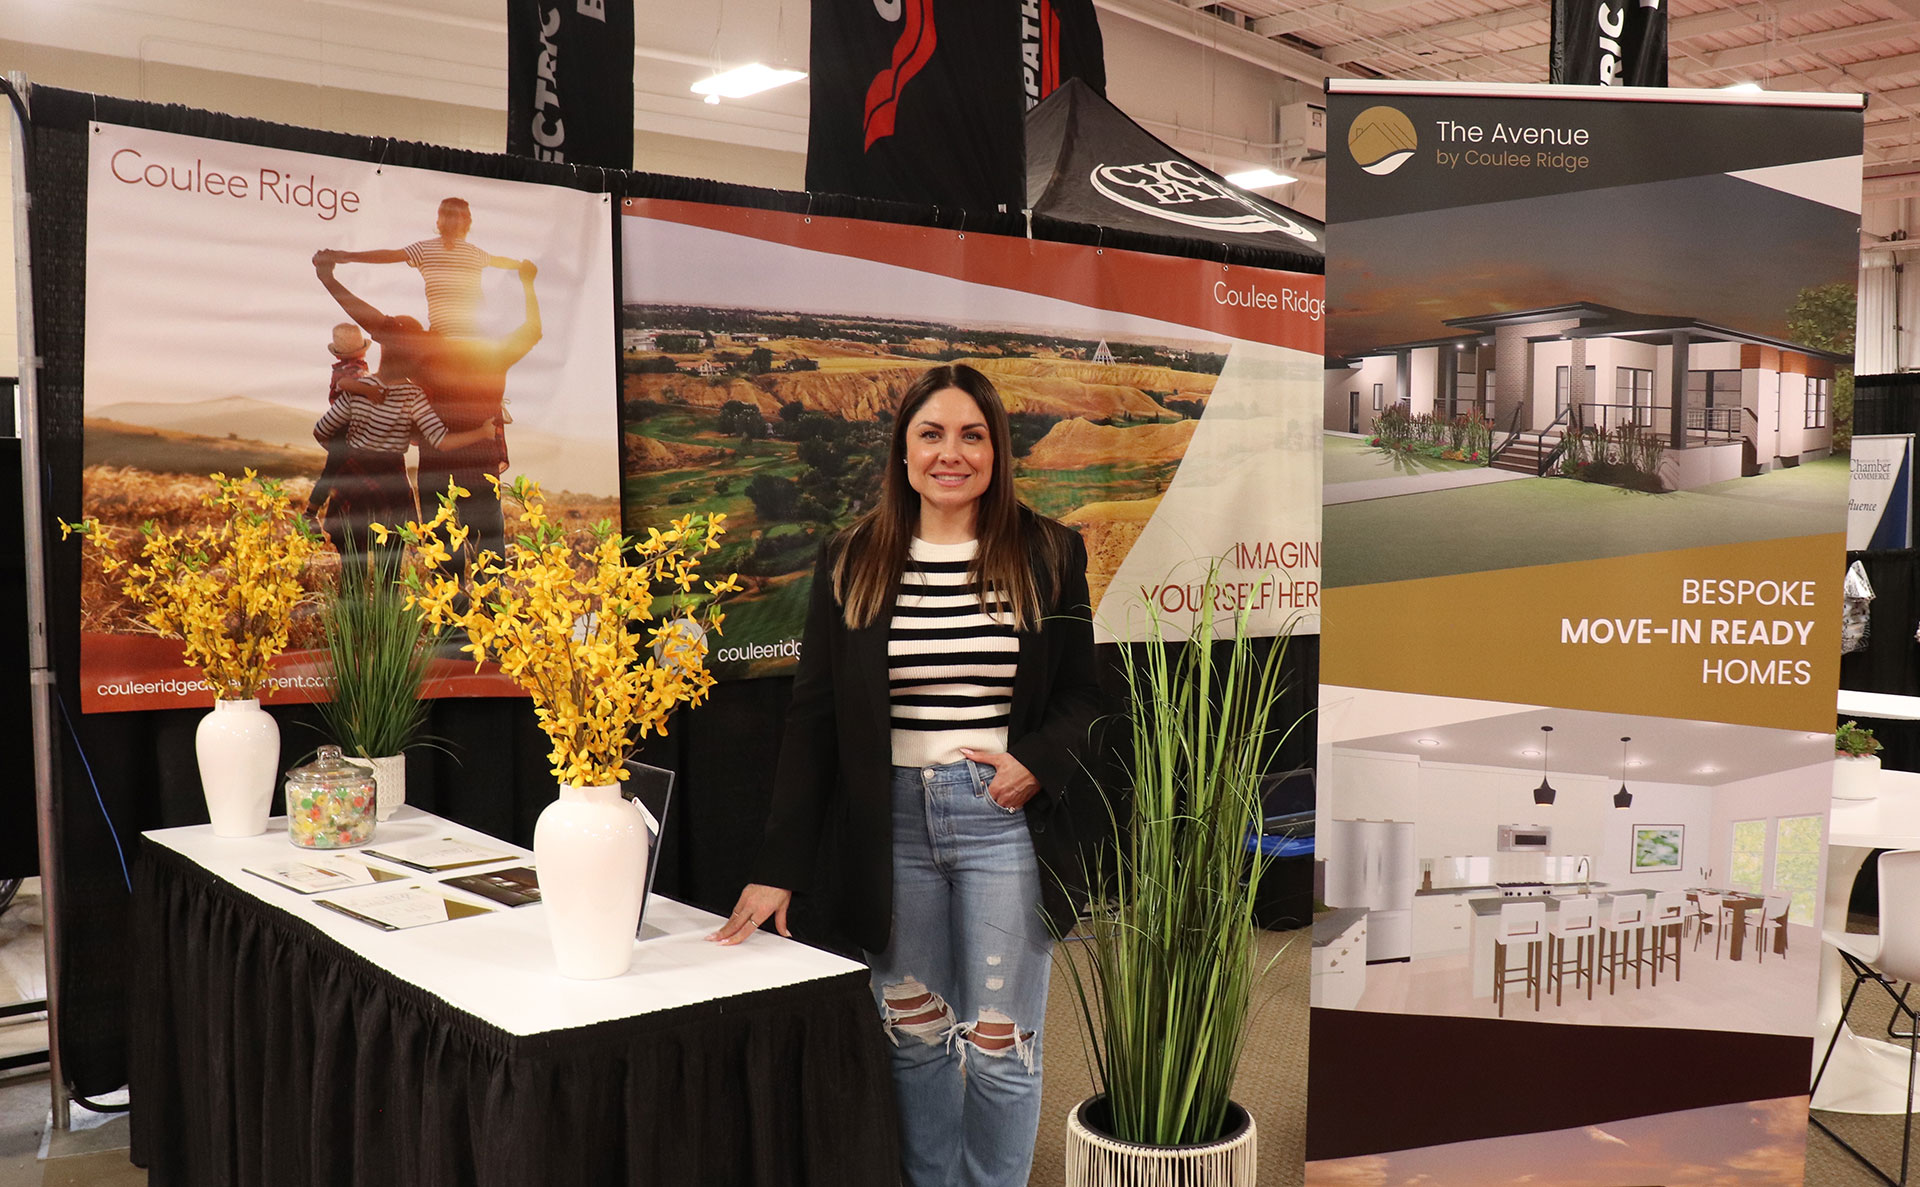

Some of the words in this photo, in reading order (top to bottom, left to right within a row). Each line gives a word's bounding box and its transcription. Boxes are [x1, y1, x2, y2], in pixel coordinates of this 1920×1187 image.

[1598, 2, 1624, 86] RIC
[1436, 120, 1484, 143] The
[1491, 123, 1589, 146] Avenue
[1436, 149, 1460, 169] by
[1465, 150, 1531, 168] Coulee
[1537, 152, 1590, 174] Ridge
[111, 148, 248, 198] Coulee
[259, 167, 360, 221] Ridge
[1213, 281, 1278, 310] Coulee
[1853, 472, 1891, 481] COMMERCE
[1235, 541, 1322, 570] IMAGIN
[1140, 582, 1272, 613] YOURSELF
[1682, 578, 1816, 606] BESPOKE
[1560, 618, 1701, 644] MOVE-IN
[1710, 619, 1815, 646] READY
[1702, 658, 1812, 685] HOMES
